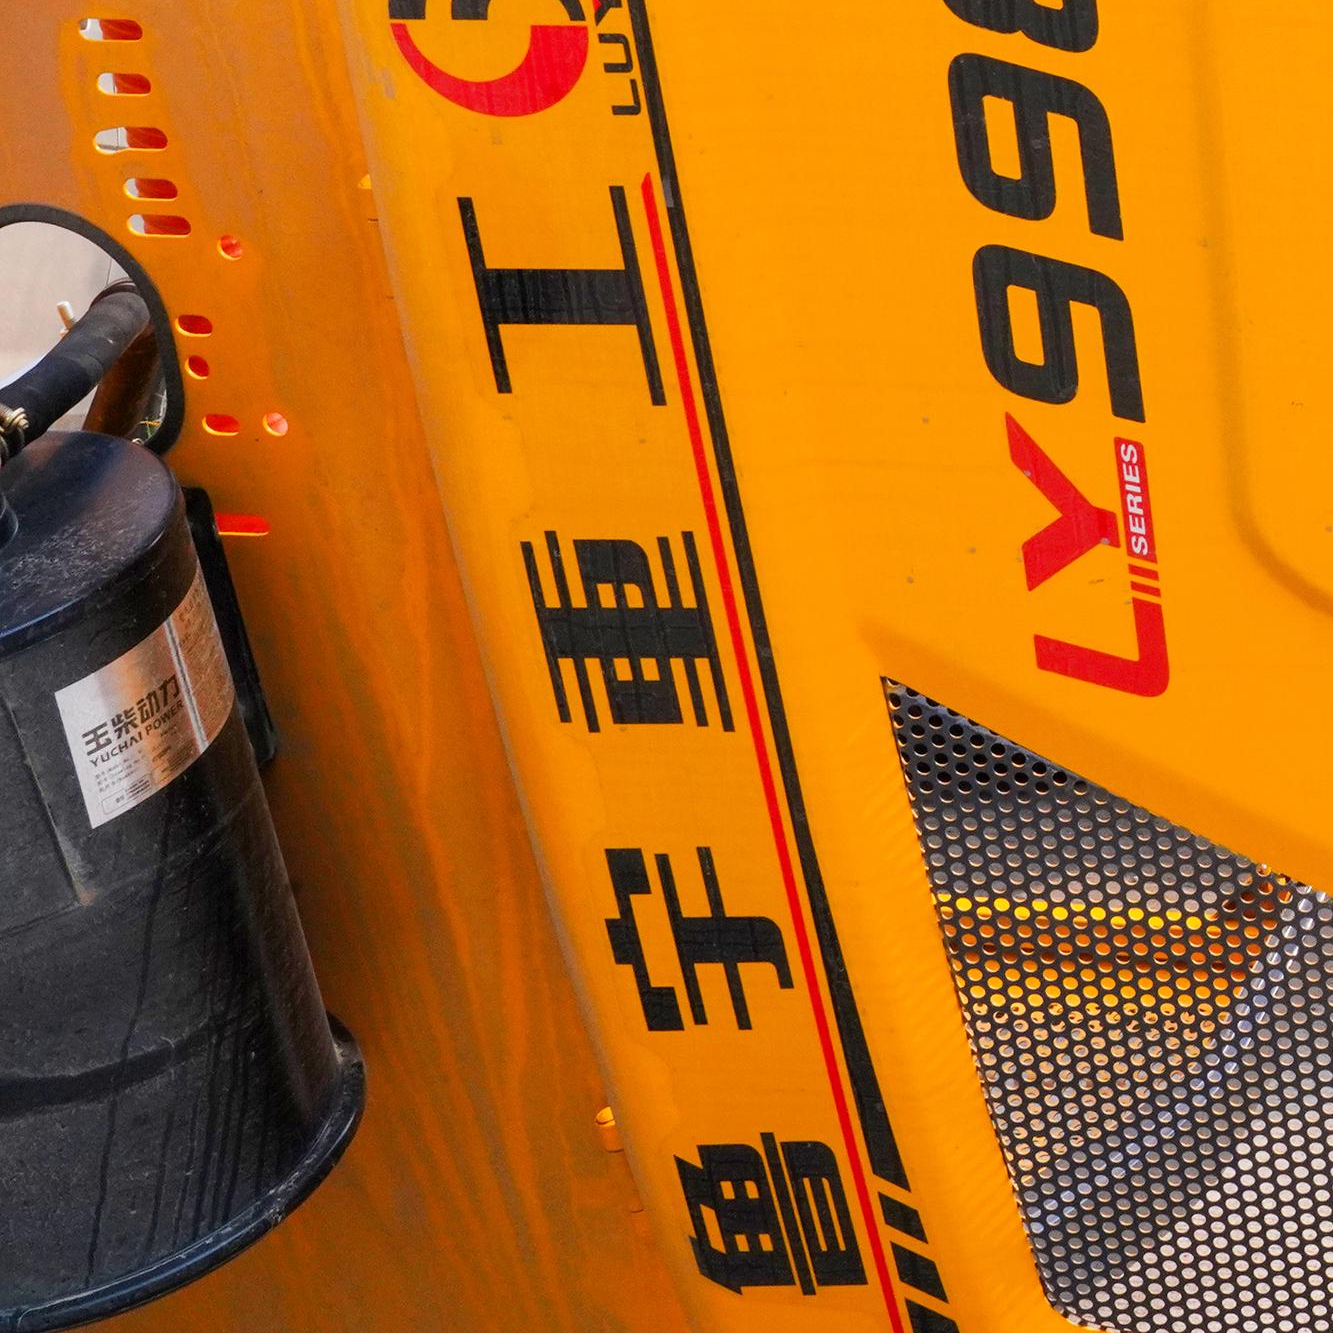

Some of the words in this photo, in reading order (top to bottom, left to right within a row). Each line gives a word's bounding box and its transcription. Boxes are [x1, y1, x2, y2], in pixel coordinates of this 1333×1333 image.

[1120, 442, 1149, 556] SERIES
[81, 673, 181, 757] 玉柴动力
[90, 731, 143, 767] YUCHAI
[144, 700, 185, 735] POWER
